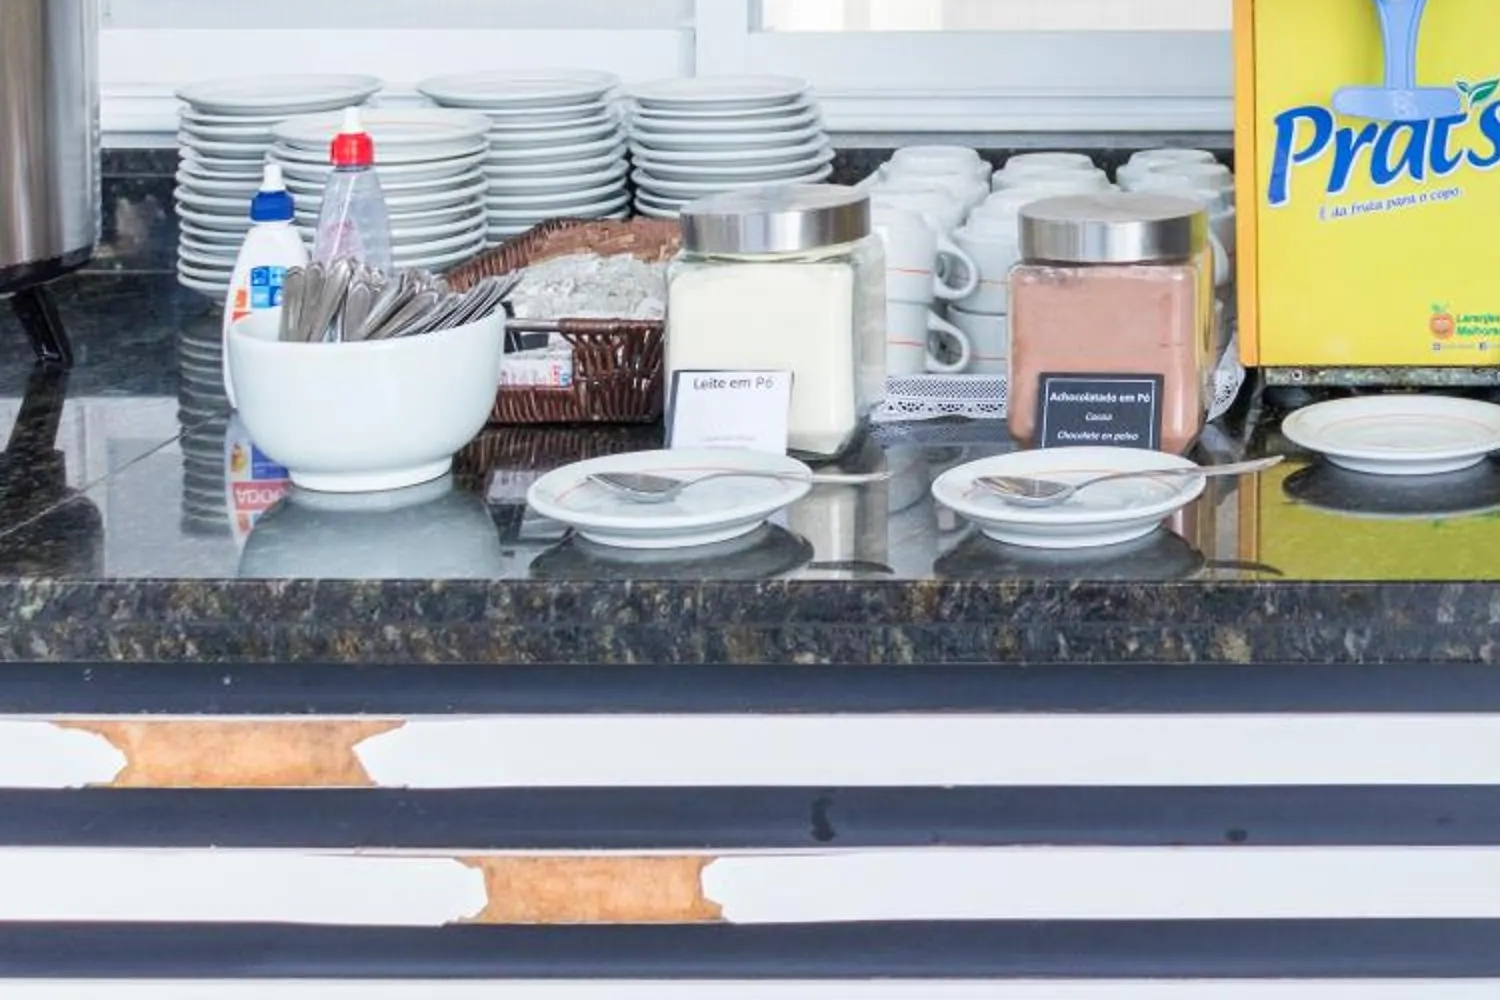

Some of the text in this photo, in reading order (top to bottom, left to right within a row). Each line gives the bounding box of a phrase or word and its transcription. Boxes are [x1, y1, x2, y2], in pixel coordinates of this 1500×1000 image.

[1385, 195, 1417, 211] para
[693, 377, 726, 390] Leite
[729, 379, 751, 389] em
[1050, 392, 1117, 403] Achocolatado
[1119, 393, 1136, 403] em
